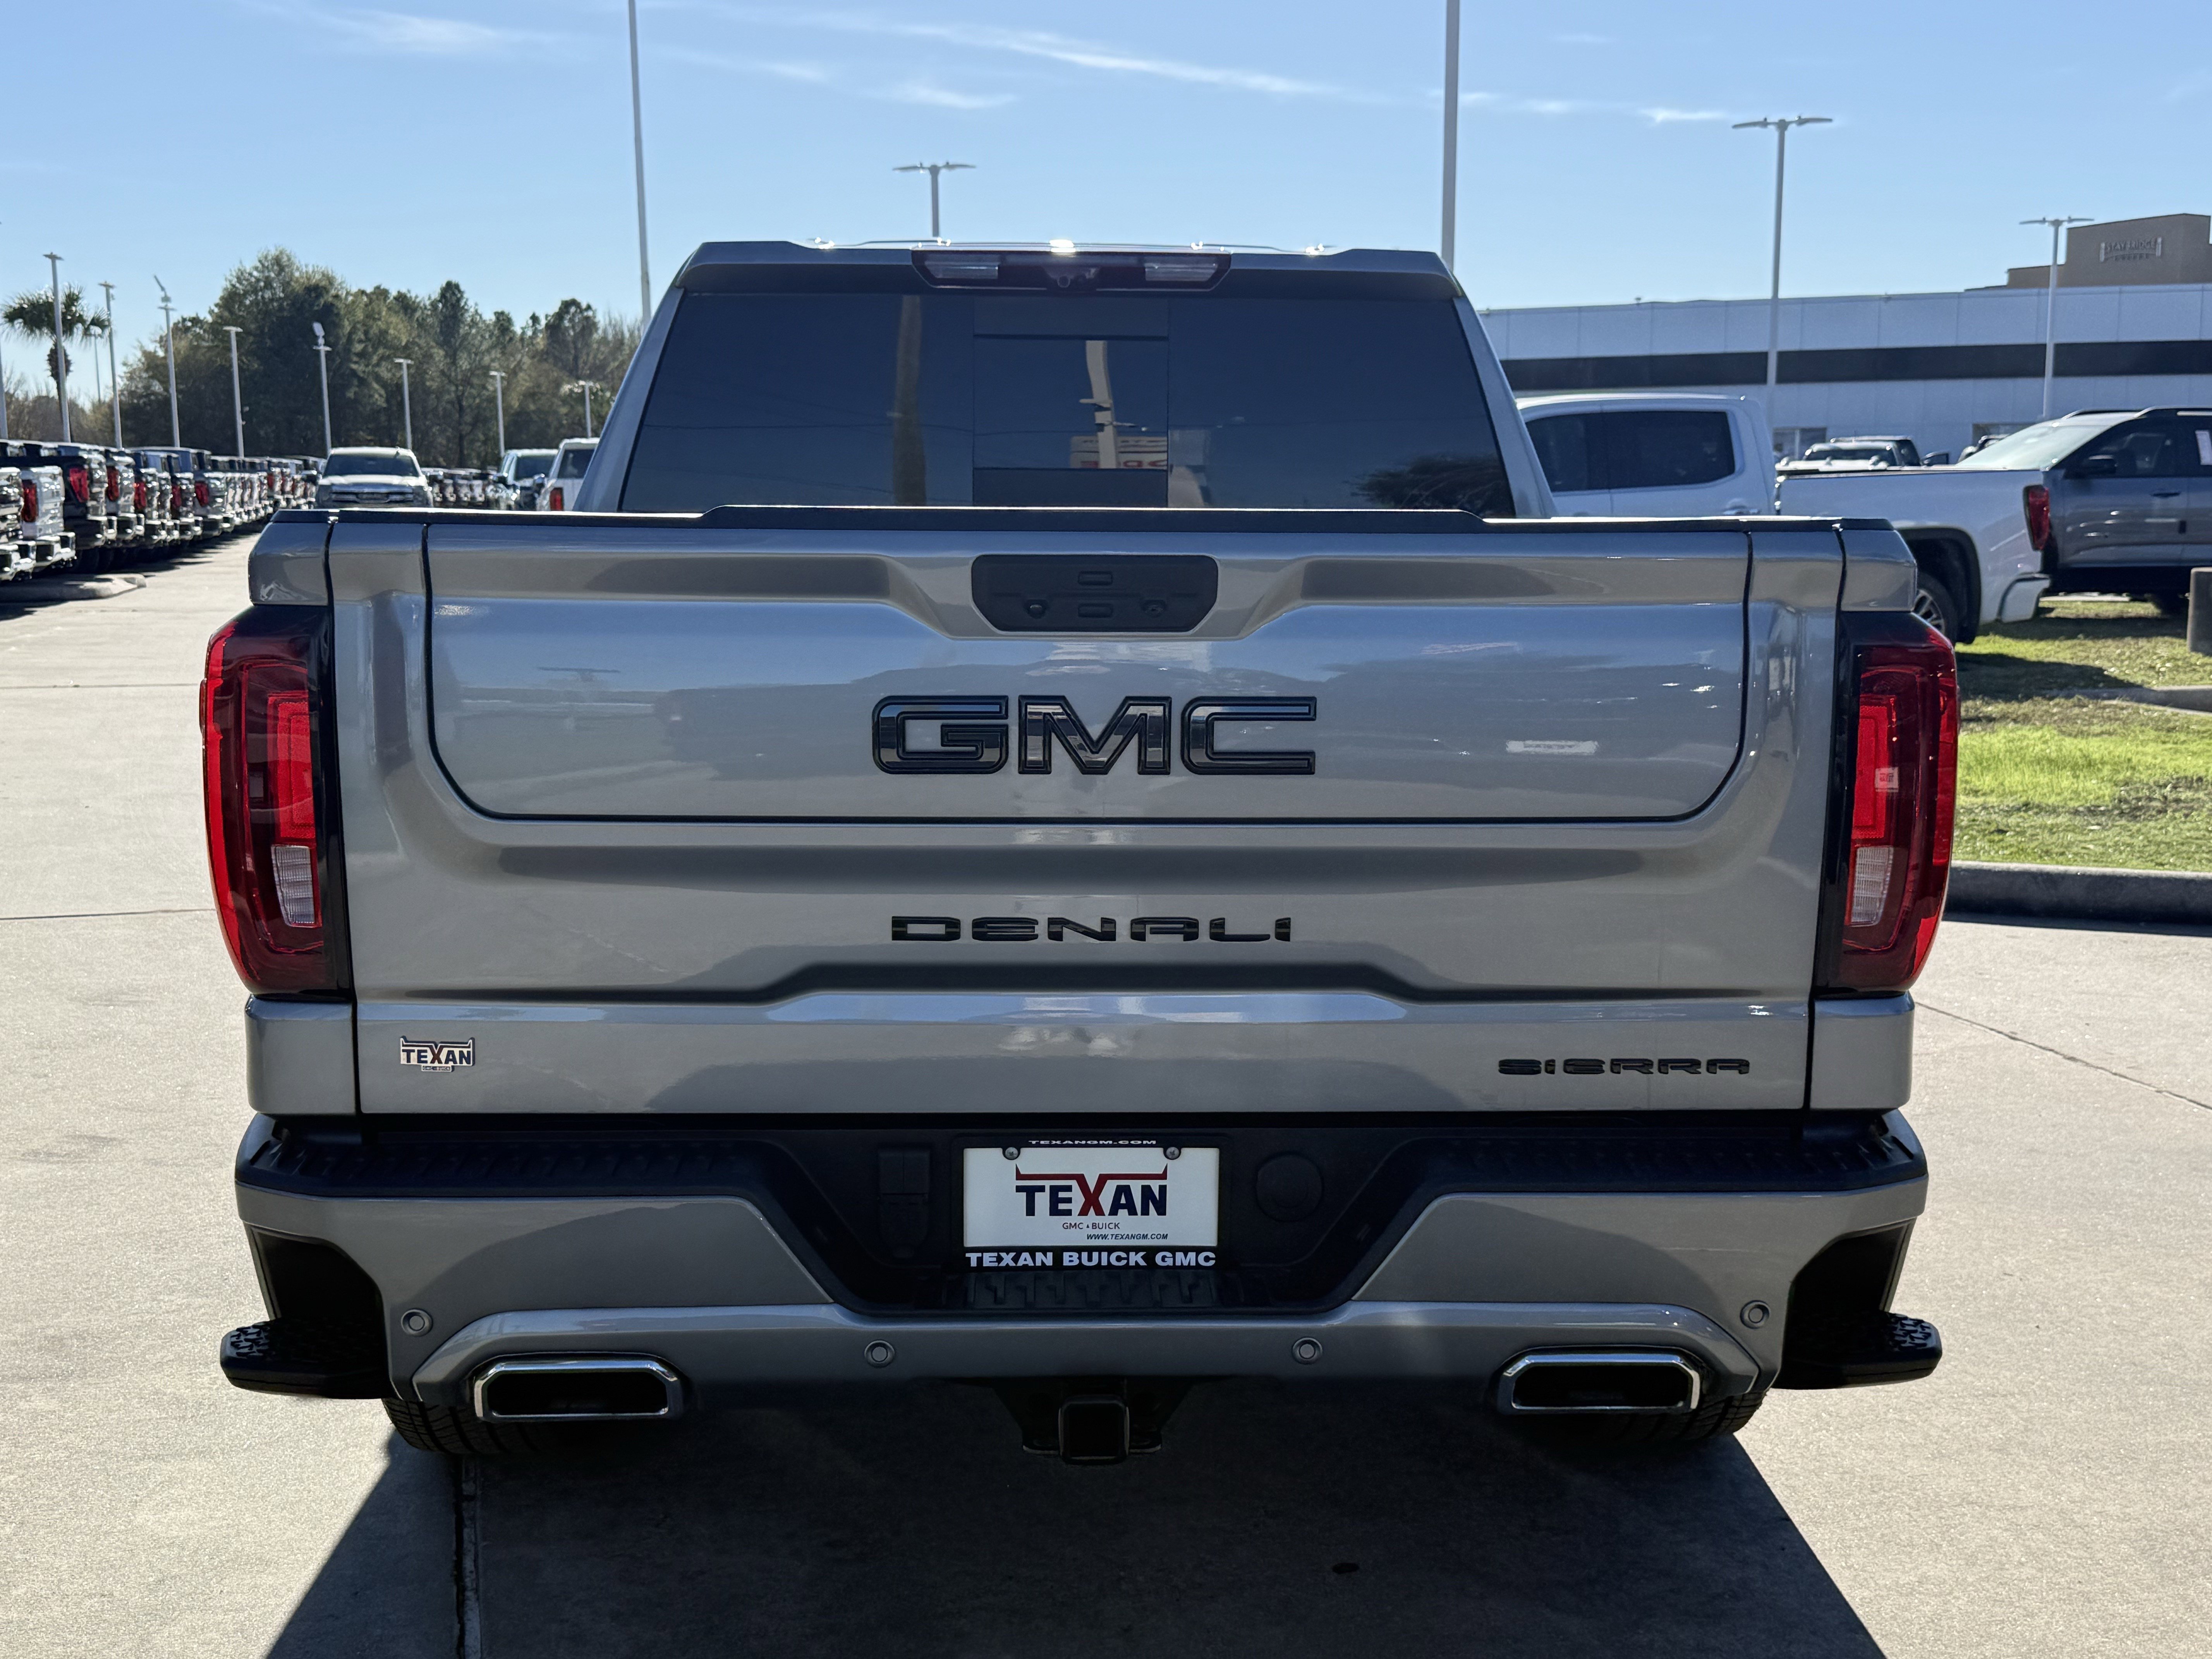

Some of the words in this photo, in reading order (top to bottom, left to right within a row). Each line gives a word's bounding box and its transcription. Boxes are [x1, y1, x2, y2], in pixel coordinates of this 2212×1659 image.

[872, 696, 1316, 775] GMC
[892, 916, 1291, 941] DENALI
[402, 1044, 471, 1065] TEXAN
[1498, 1058, 1750, 1075] SIERRA
[1015, 1173, 1168, 1216] TEXAN
[965, 1252, 1053, 1267] TEXAN
[1063, 1251, 1147, 1266] BUICK
[1155, 1252, 1216, 1266] GMC
